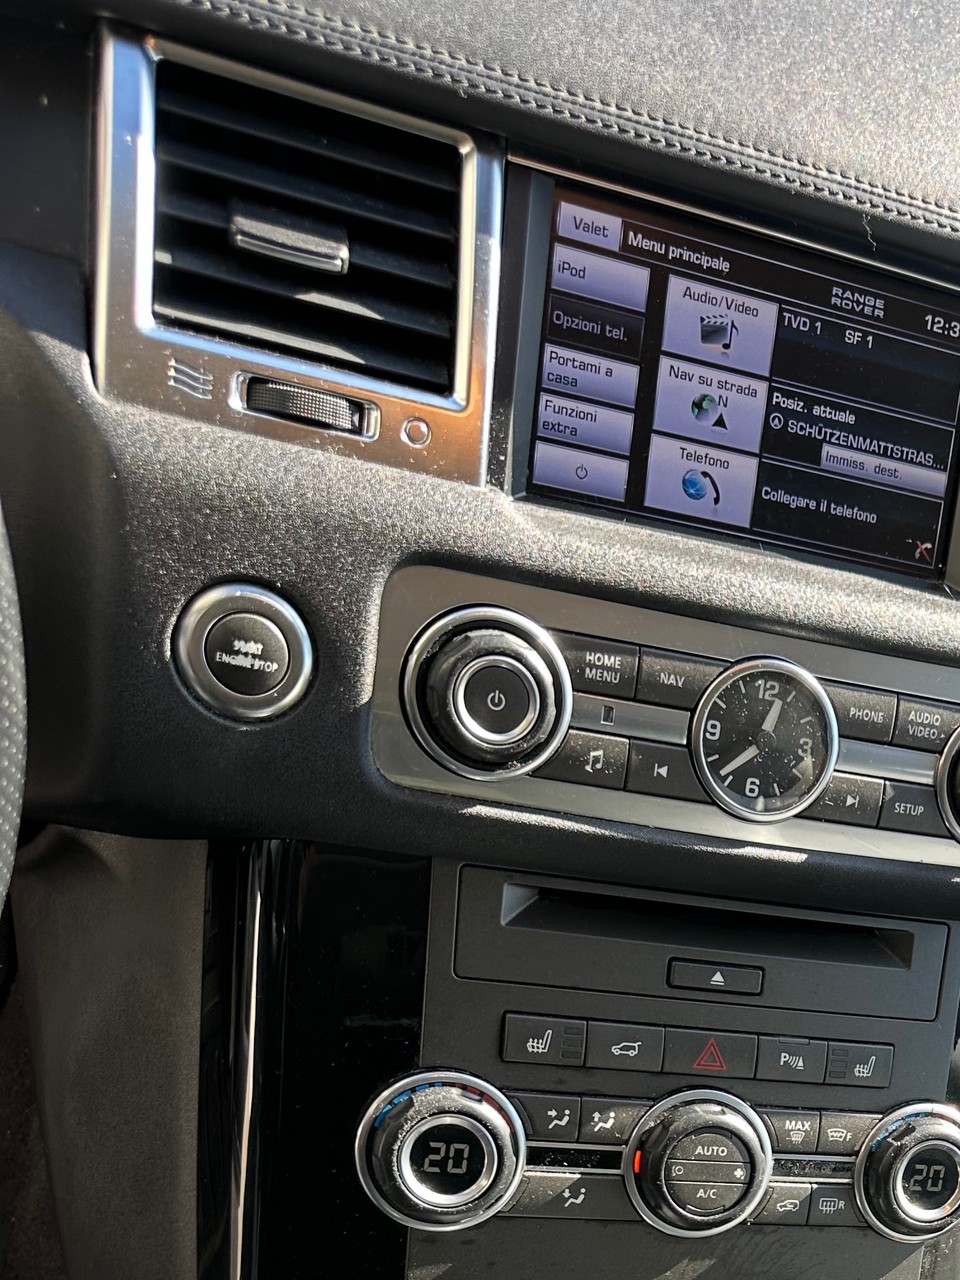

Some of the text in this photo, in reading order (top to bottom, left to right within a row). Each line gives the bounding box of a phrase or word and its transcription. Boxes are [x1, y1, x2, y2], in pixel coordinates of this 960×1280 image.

[573, 216, 609, 238] Valet
[628, 231, 730, 273] Menu principale
[558, 260, 586, 279] iPod
[683, 286, 759, 318] Audio/Video
[831, 286, 885, 309] RANGE
[831, 297, 885, 319] ROVER
[553, 311, 628, 341] Opzioni tel.
[783, 312, 873, 349] TVD 1 SF 1
[549, 351, 613, 378] Portami a
[547, 372, 578, 388] casa
[669, 365, 758, 399] Nav su strada
[544, 400, 597, 423] Funzioni
[772, 392, 856, 425] Posiz. attuale
[542, 421, 578, 437] extra
[679, 447, 730, 470] Telefono
[825, 451, 903, 480] Immiss. dest.
[761, 486, 877, 524] Collegare il telefono
[585, 651, 622, 669] HOME
[585, 667, 620, 683] MENU
[660, 672, 685, 688] NAV
[755, 679, 780, 701] 12
[849, 707, 884, 724] PHONE
[908, 710, 941, 725] AUDIO
[705, 720, 721, 741] 9
[908, 724, 938, 739] VIDEO
[798, 737, 813, 757] 3
[745, 778, 760, 797] 6
[894, 802, 924, 816] SETUP
[785, 1120, 811, 1131] MAX
[423, 1141, 470, 1174] 20
[695, 1146, 728, 1156] AUTO
[909, 1164, 945, 1192] 20
[696, 1188, 718, 1199] A/C
